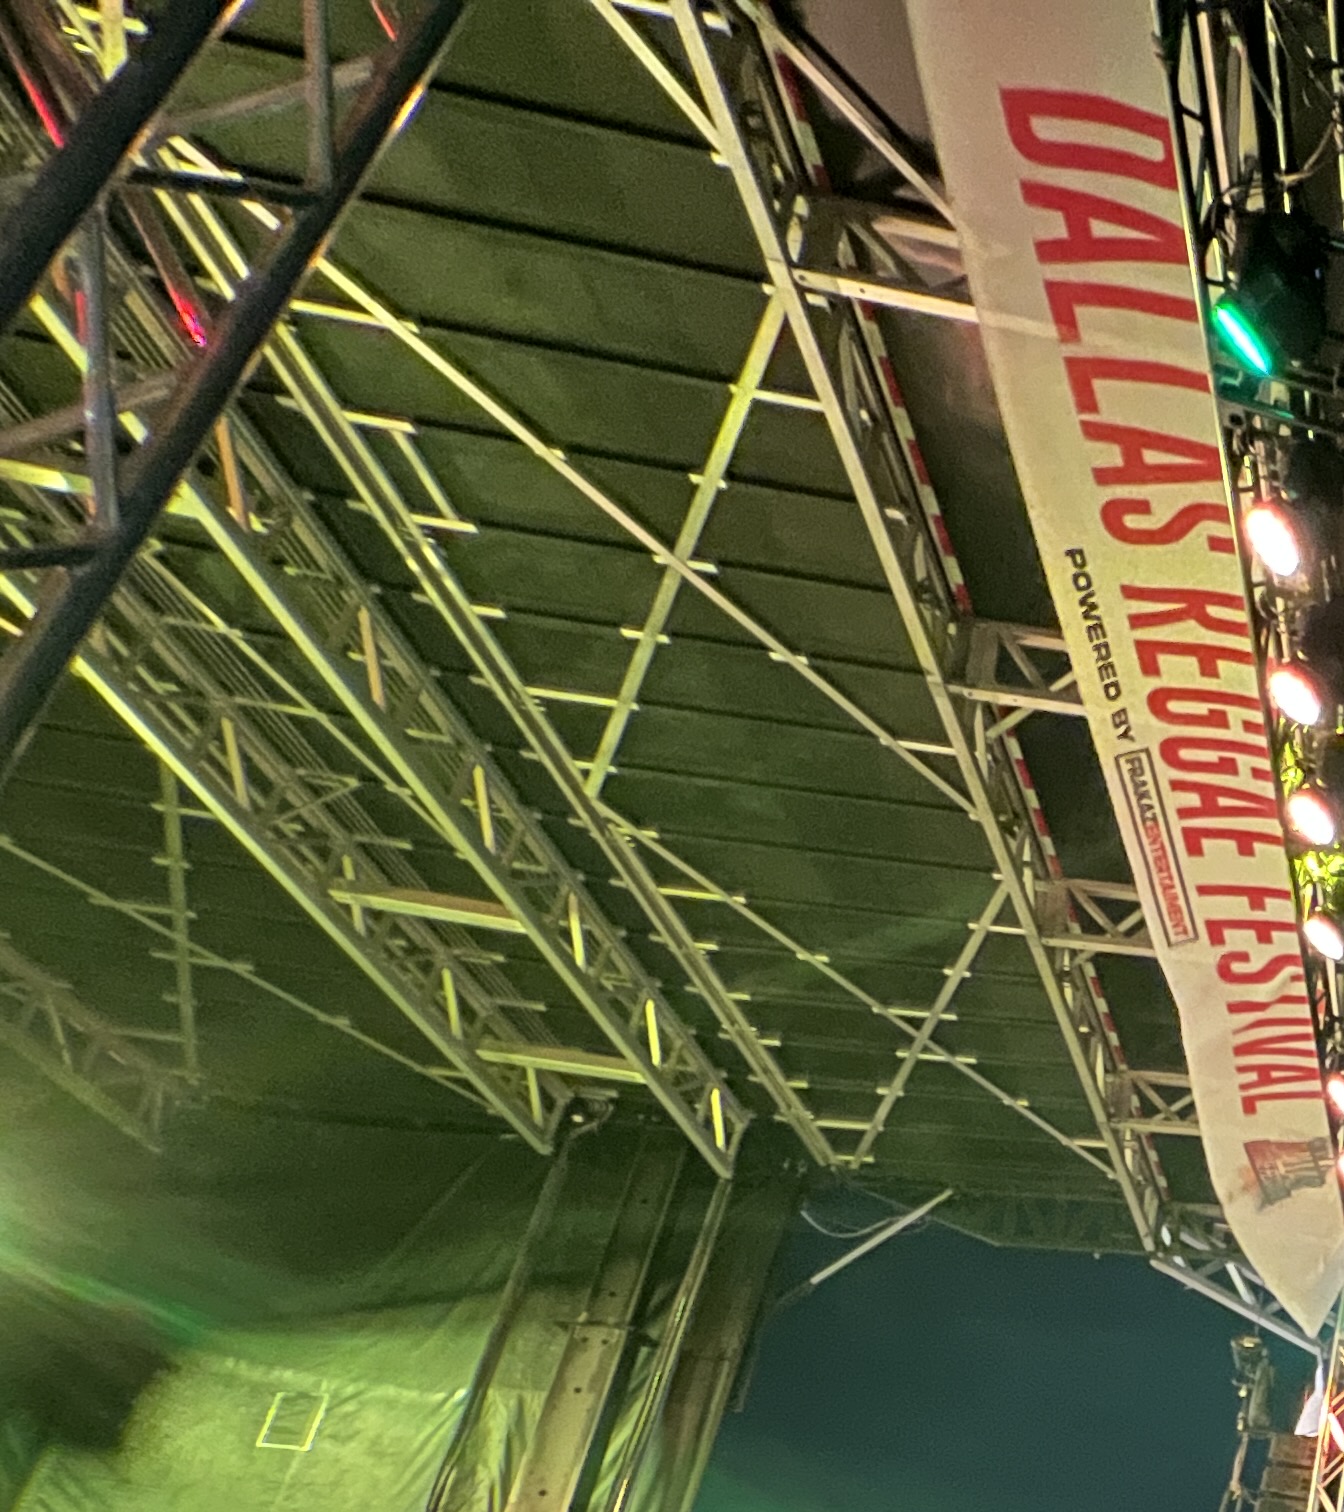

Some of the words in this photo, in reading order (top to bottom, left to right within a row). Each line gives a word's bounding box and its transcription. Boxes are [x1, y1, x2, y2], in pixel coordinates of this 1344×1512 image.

[1000, 86, 1236, 553] DALLAS
[1120, 585, 1285, 857] REGGAE
[1064, 548, 1122, 702] POWERED
[1111, 707, 1136, 743] BY
